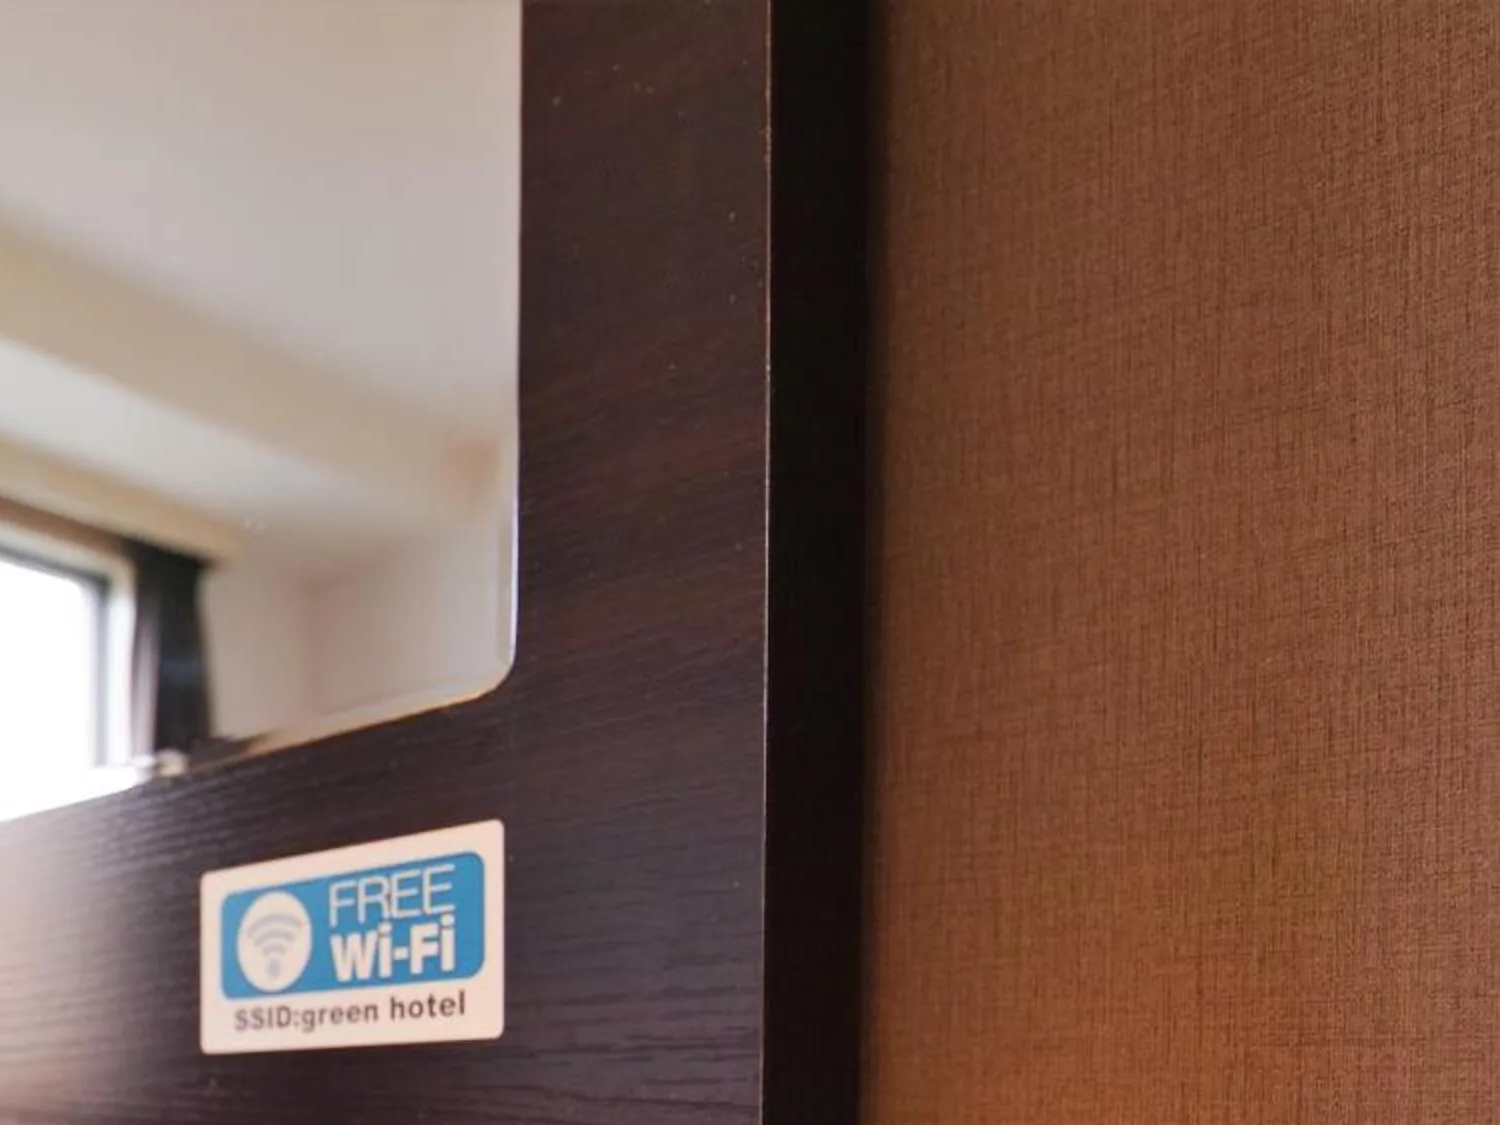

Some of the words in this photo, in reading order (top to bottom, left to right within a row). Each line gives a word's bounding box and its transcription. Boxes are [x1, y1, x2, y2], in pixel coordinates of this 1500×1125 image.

[328, 864, 455, 928] FREE
[330, 913, 455, 982] Wi-Fi
[234, 1003, 379, 1033] SSID:green
[390, 989, 466, 1020] hotel
